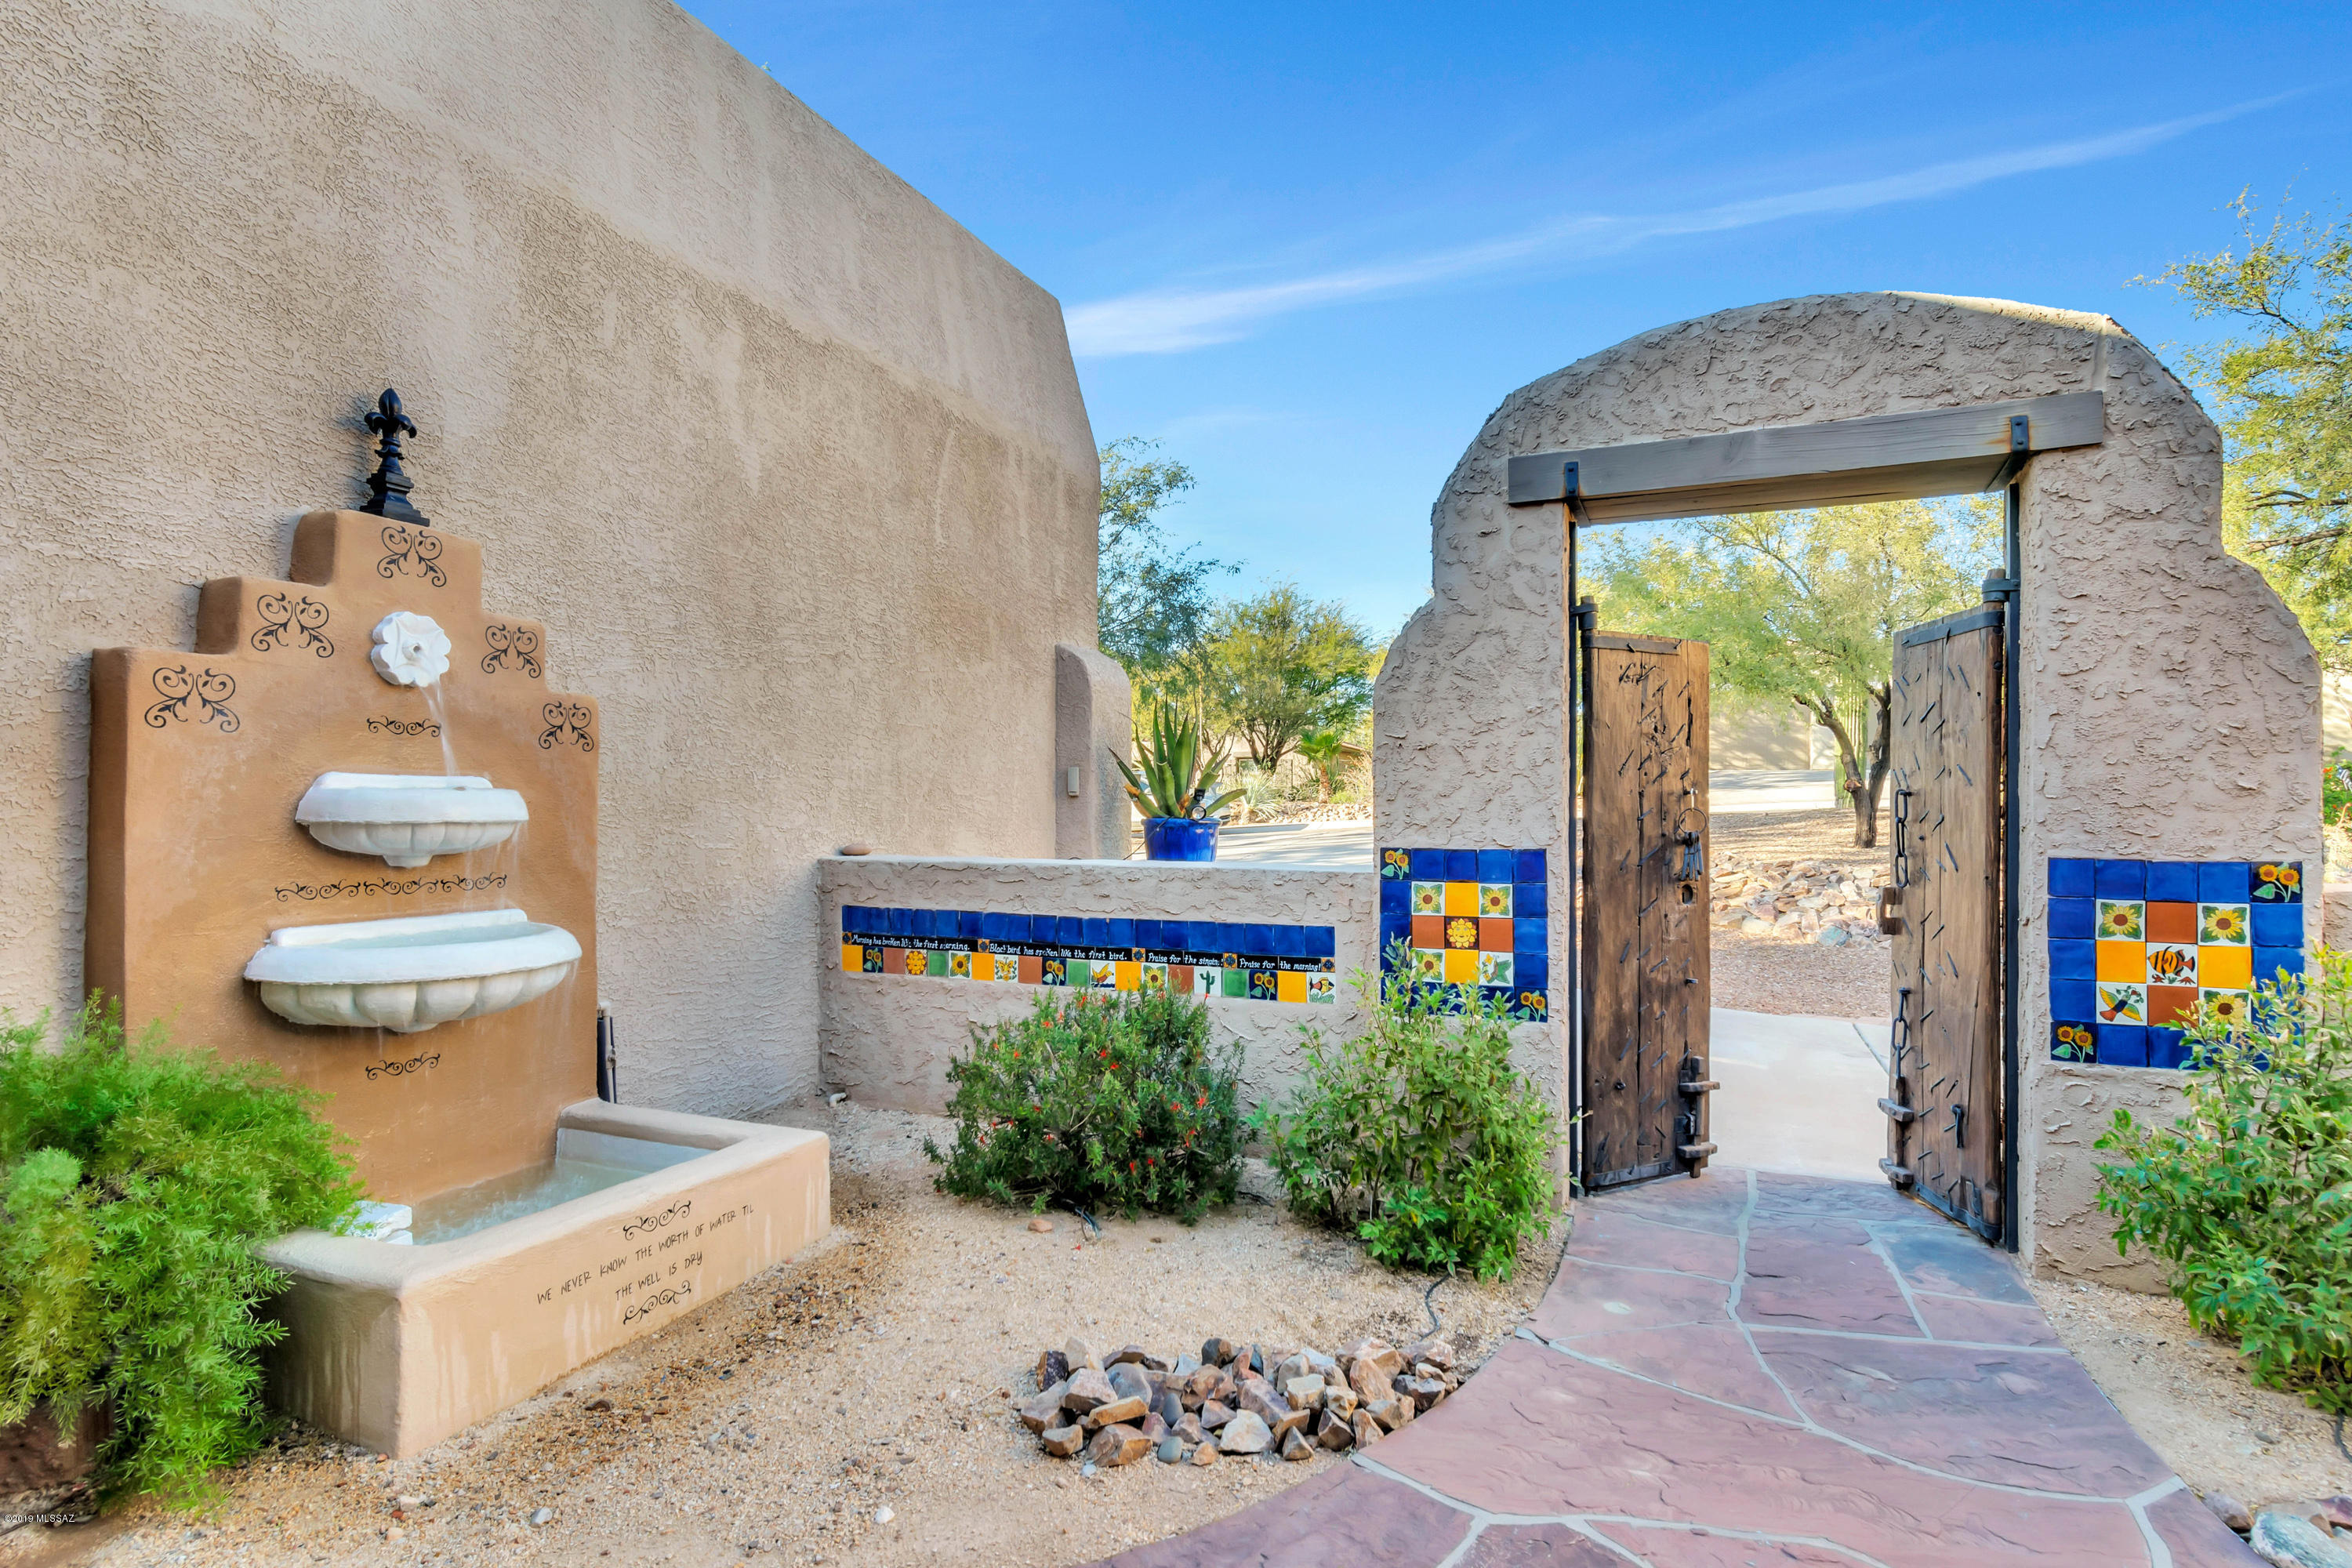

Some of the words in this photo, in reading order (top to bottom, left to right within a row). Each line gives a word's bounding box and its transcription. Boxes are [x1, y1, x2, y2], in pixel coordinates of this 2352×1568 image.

[873, 936, 881, 945] has
[913, 938, 923, 948] the
[924, 939, 938, 949] first
[1023, 946, 1034, 955] has
[1074, 949, 1086, 958] the
[1089, 950, 1105, 960] first
[1109, 951, 1127, 960] bird.
[1148, 953, 1168, 963] Praise
[1169, 954, 1181, 964] for
[1184, 954, 1197, 964] the
[1240, 957, 1261, 968] Praise
[1262, 960, 1276, 969] for
[1279, 960, 1291, 970] the
[1293, 963, 1321, 972] morning!
[537, 1289, 552, 1305] WE
[561, 1272, 592, 1295] NEVER
[600, 1256, 627, 1277] KNOW
[635, 1244, 652, 1261] THE
[659, 1230, 689, 1252] WORTH
[695, 1223, 705, 1237] OF
[710, 1210, 736, 1232] WATER
[742, 1203, 754, 1217] TIL
[615, 1281, 633, 1301] THE
[637, 1272, 661, 1290] WELL
[669, 1263, 677, 1277] IS
[684, 1250, 702, 1270] DRY
